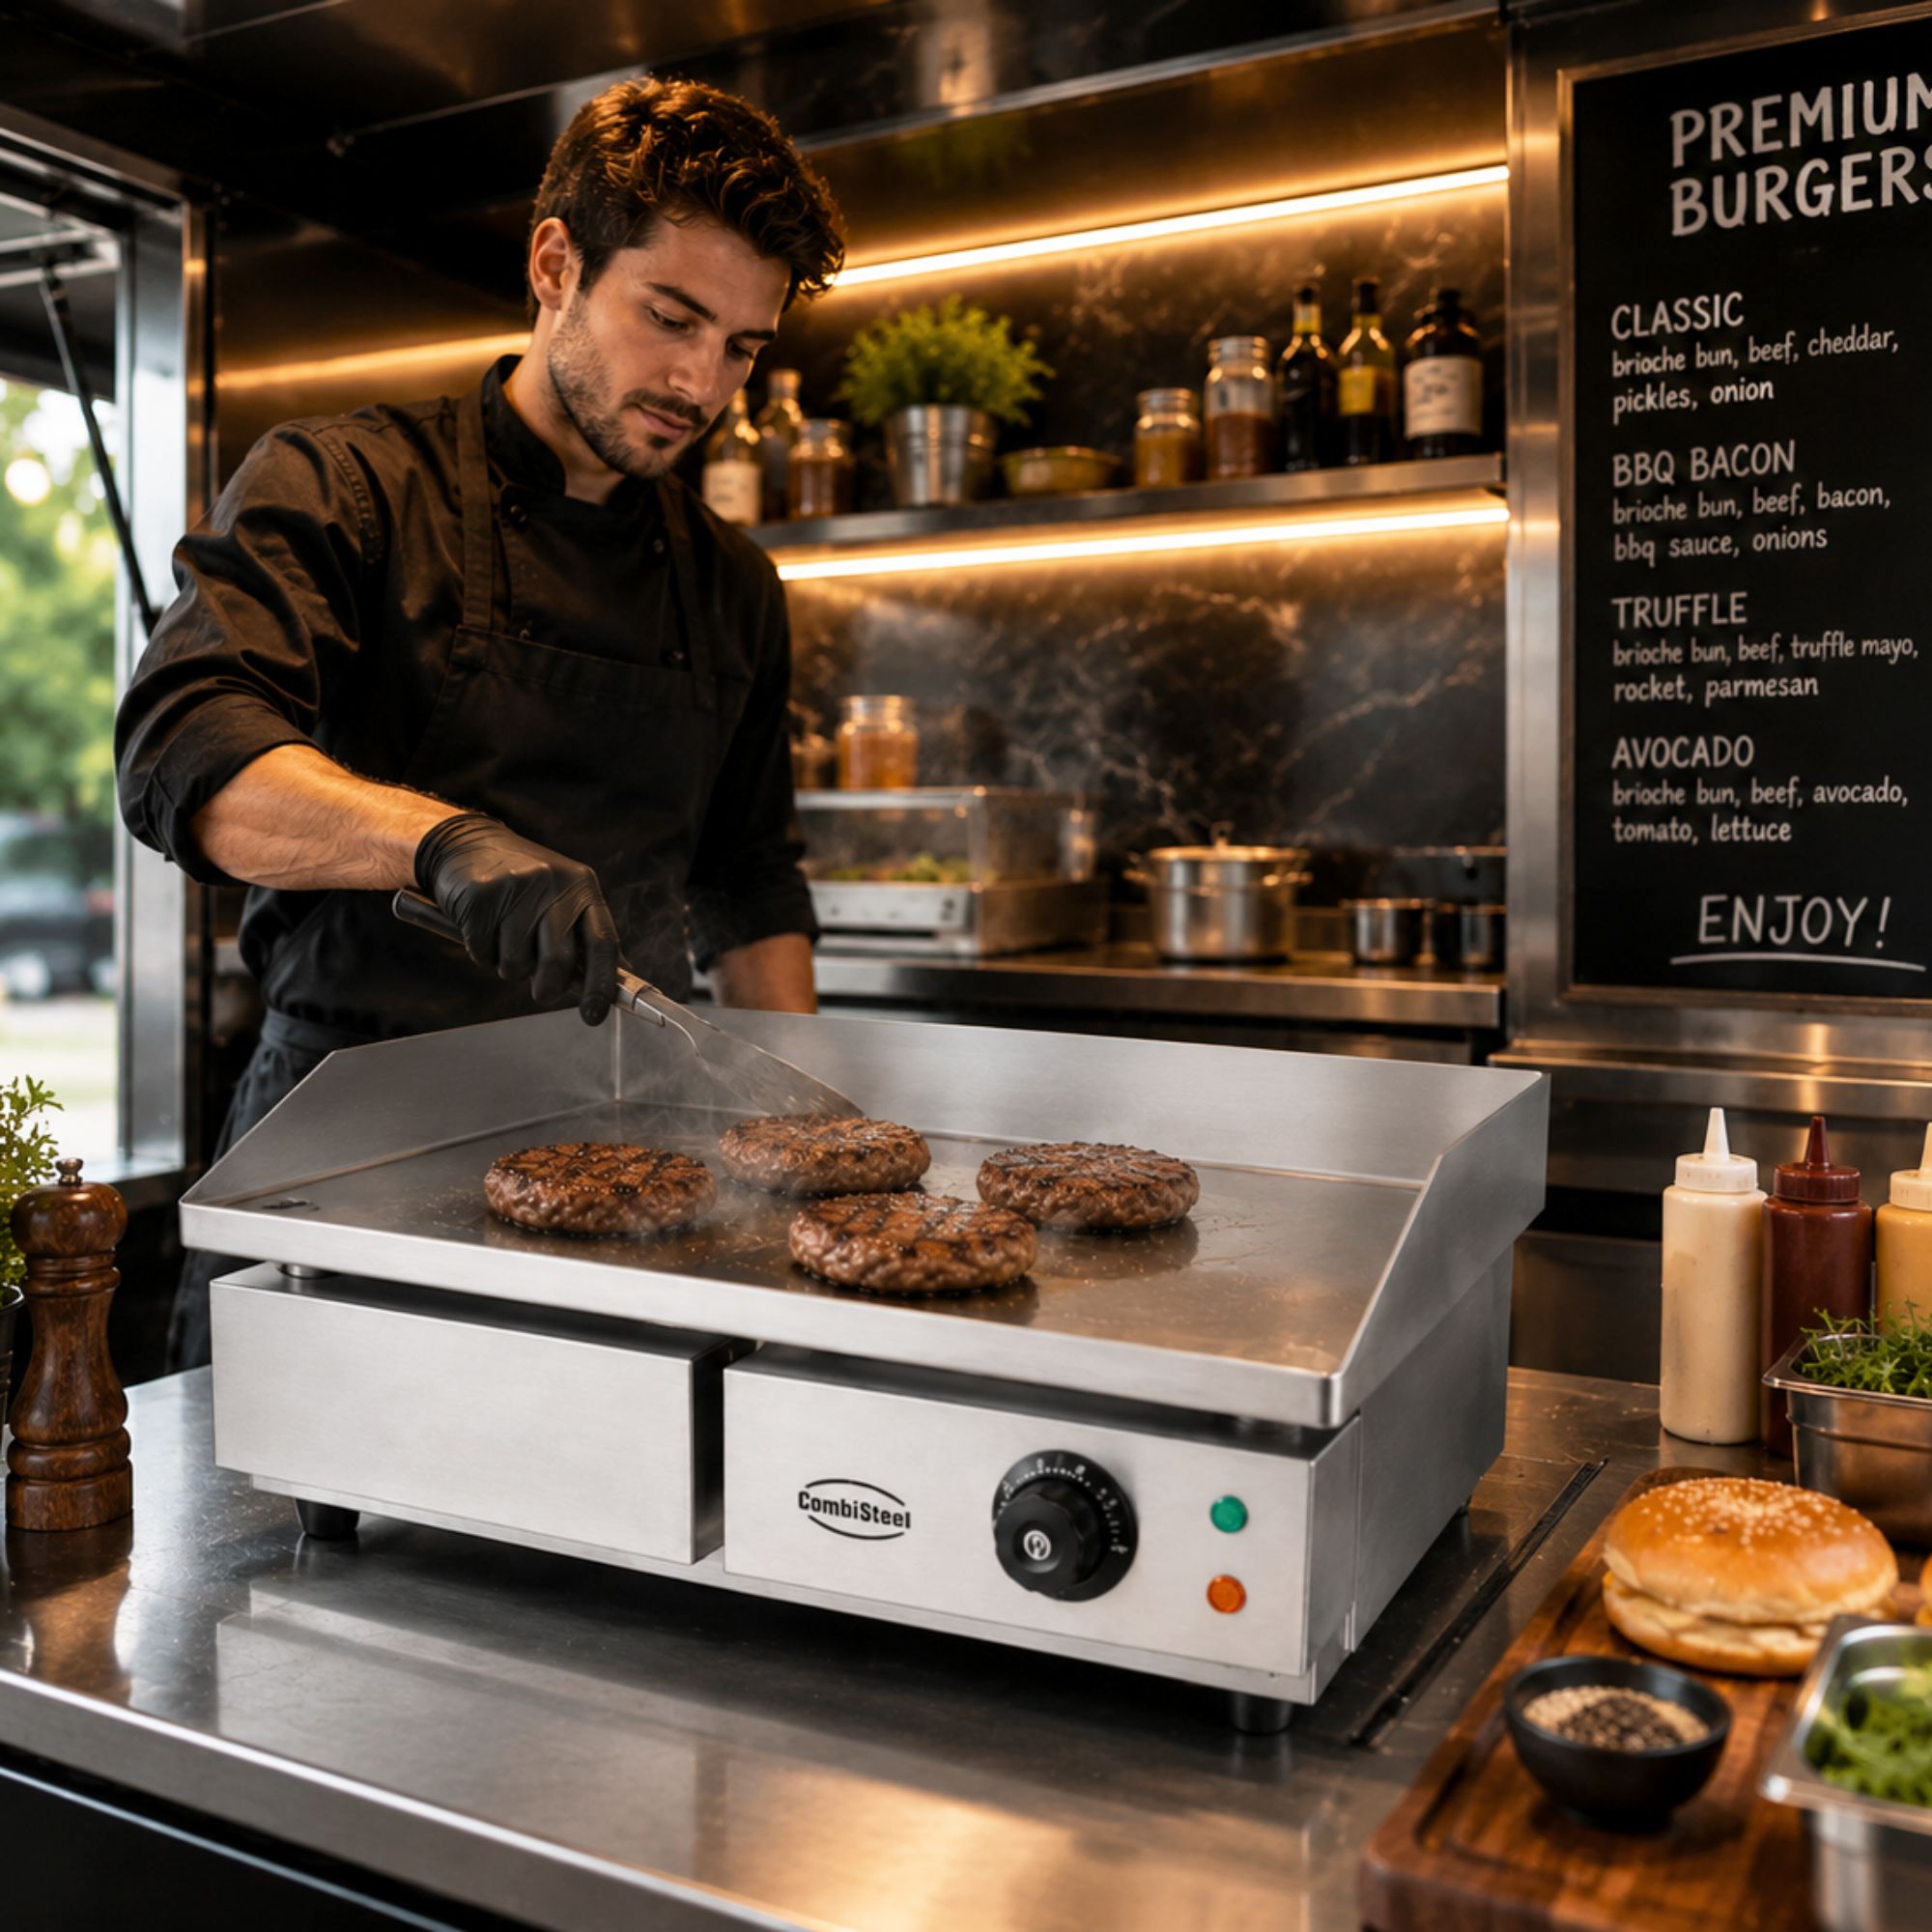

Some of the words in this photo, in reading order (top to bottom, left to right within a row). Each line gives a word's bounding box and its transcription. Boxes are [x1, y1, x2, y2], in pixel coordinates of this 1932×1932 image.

[1670, 145, 1932, 238] BURGER
[1611, 291, 1745, 340] CLASSIC
[1612, 346, 1687, 378] brioche
[1695, 342, 1739, 369] bun,
[1748, 330, 1799, 364] beef,
[1807, 323, 1899, 353] cheddar,
[1613, 382, 1698, 425] pickles,
[1710, 377, 1775, 405] onion
[1612, 450, 1675, 488] BBQ
[1690, 440, 1795, 481] BACON
[1613, 495, 1687, 525] brioche
[1697, 491, 1743, 519] bun,
[1752, 482, 1805, 516] beef,
[1817, 481, 1890, 509] bacon,
[1614, 532, 1655, 567] bbq
[1669, 535, 1740, 557] sauce,
[1752, 525, 1828, 552] onions
[1611, 591, 1747, 629] TRUFFLE
[1613, 639, 1683, 666] brioche
[1691, 638, 1731, 664] bun,
[1738, 633, 1784, 664] beef,
[1790, 630, 1855, 661] truffle
[1861, 638, 1918, 665] mayo,
[1614, 673, 1693, 702] rocket,
[1705, 677, 1819, 708] parmesan
[1611, 734, 1754, 769] AVOCADO
[1612, 780, 1685, 806] brioche
[1696, 779, 1741, 808] bun,
[1750, 776, 1803, 809] beef,
[1812, 775, 1908, 808] avocado,
[1612, 817, 1698, 845] tomato,
[1711, 813, 1792, 842] lettuce
[1698, 895, 1891, 950] ENJOY!
[798, 1491, 911, 1529] CombiSteel
